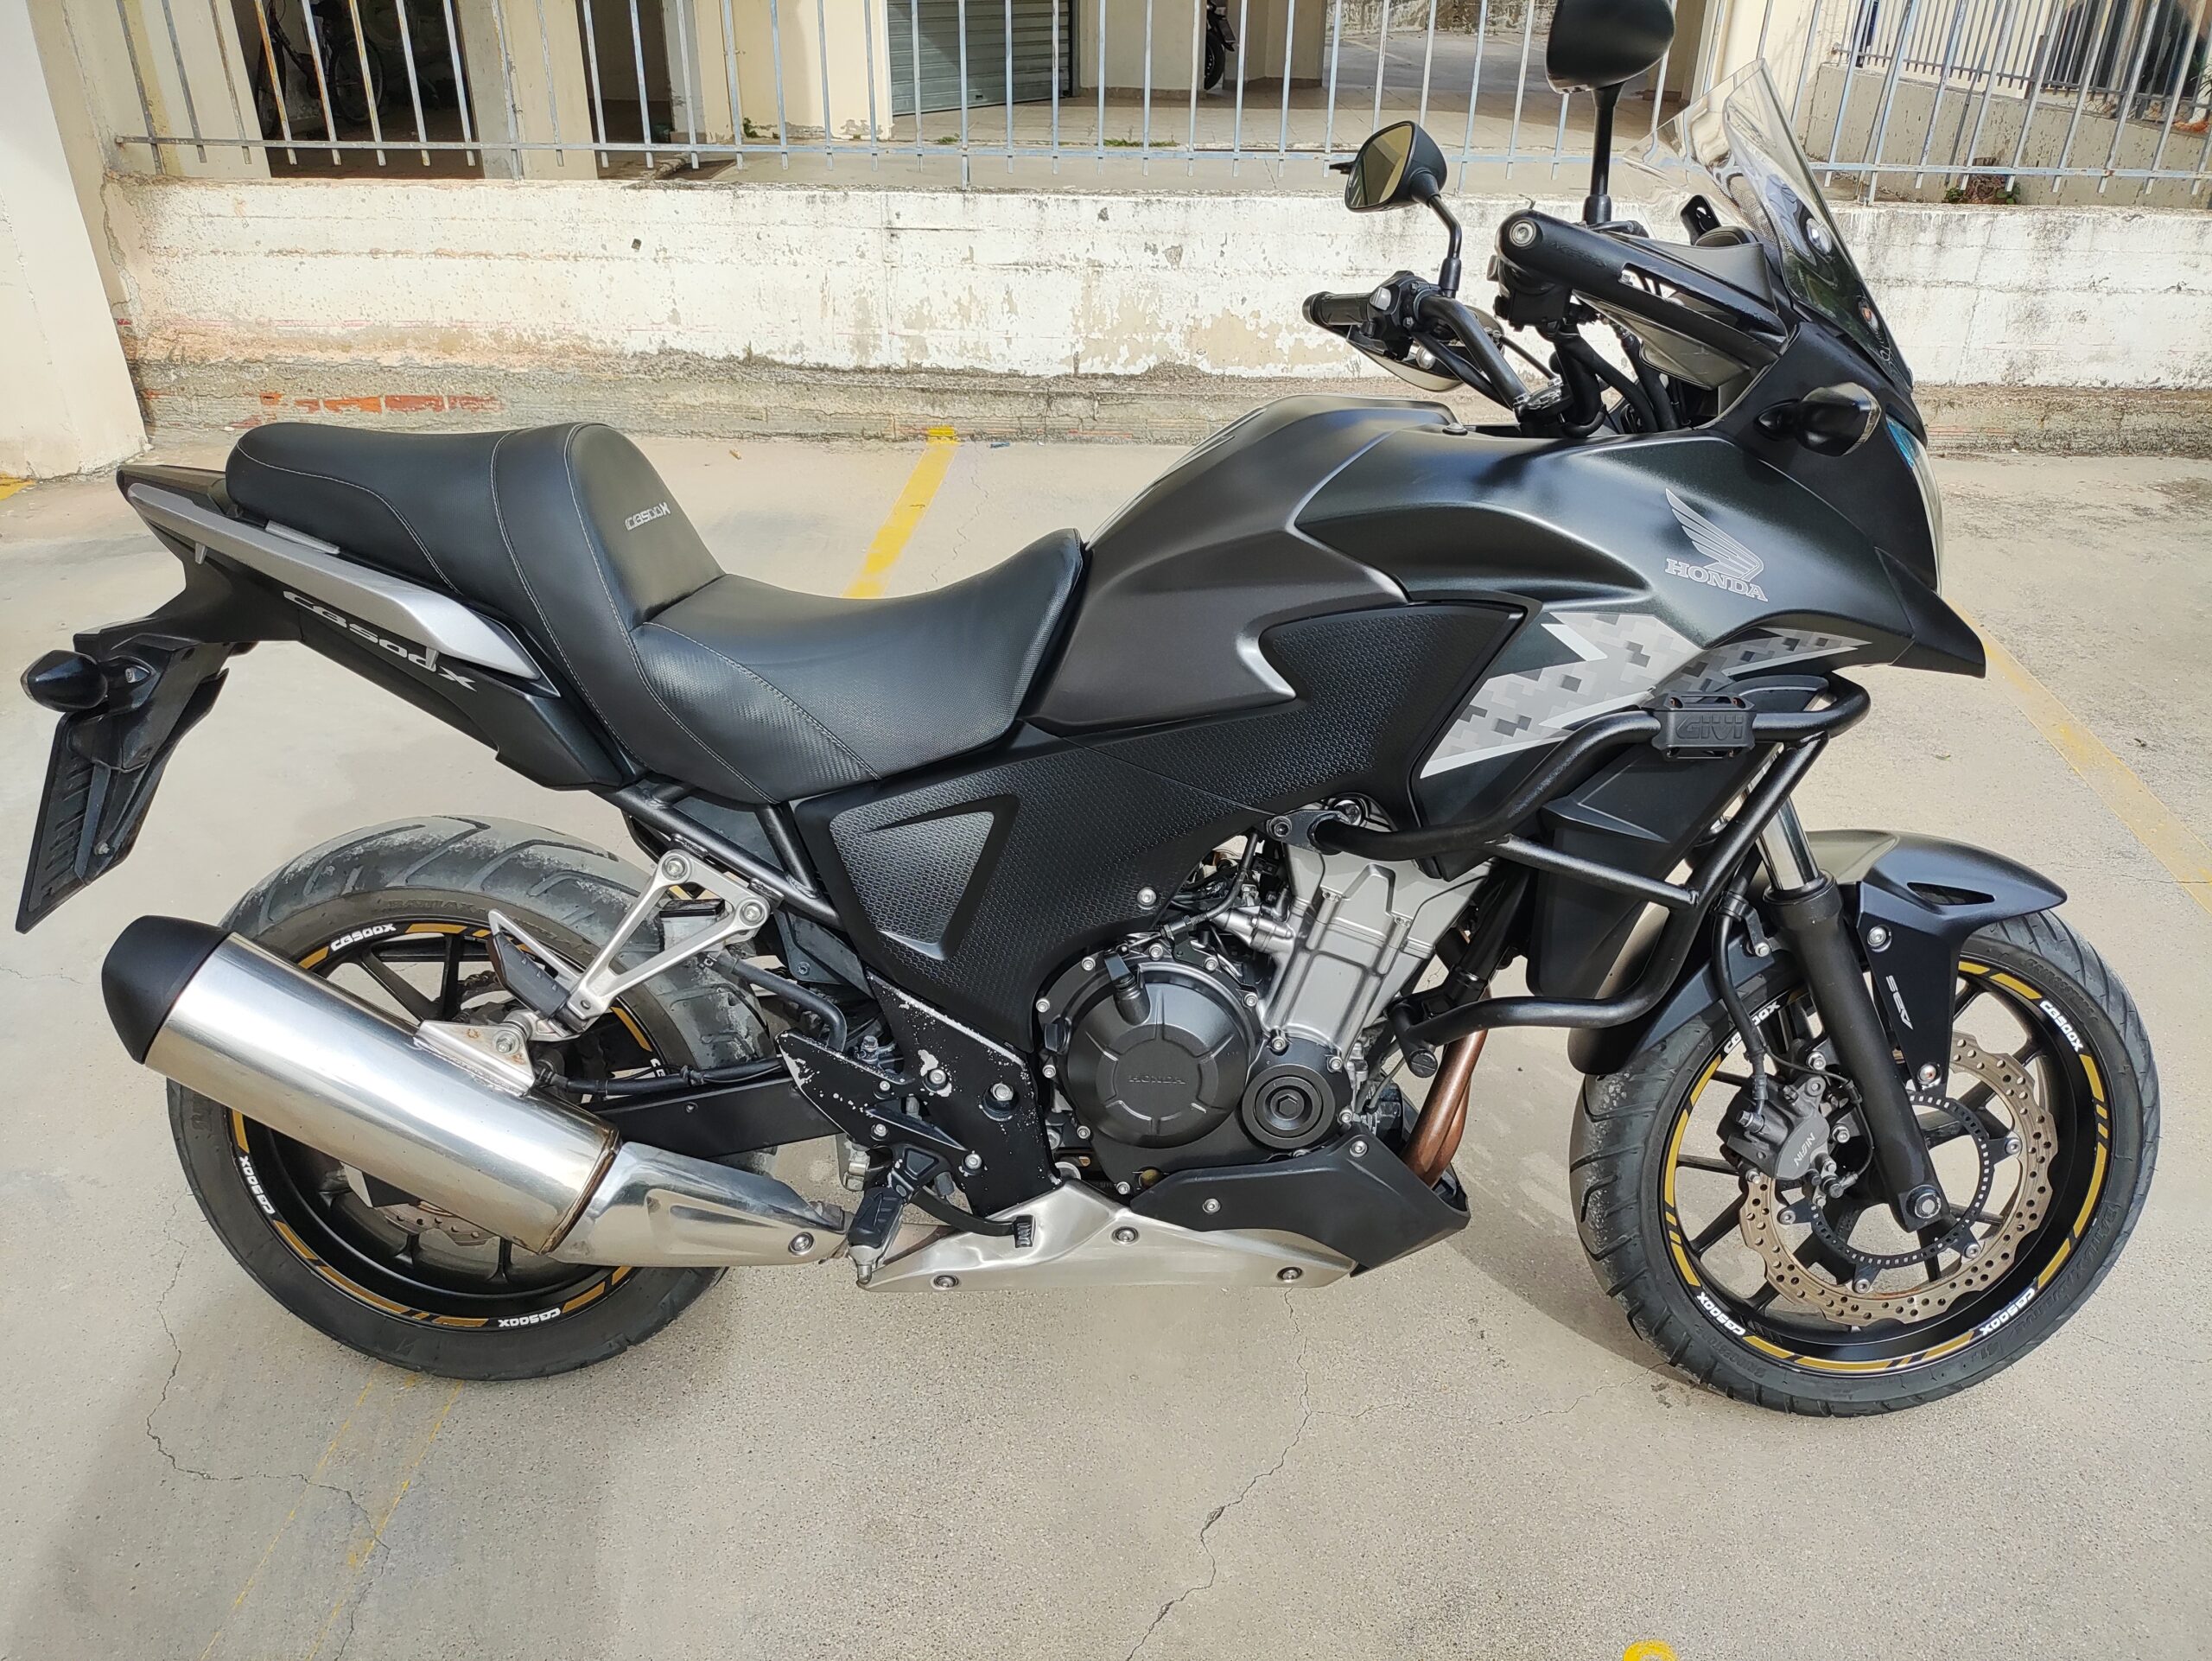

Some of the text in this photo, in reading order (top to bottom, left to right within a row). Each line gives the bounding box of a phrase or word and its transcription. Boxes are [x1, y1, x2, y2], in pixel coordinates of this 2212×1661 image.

[1665, 557, 1769, 602] HONDA
[283, 590, 477, 692] CB500X
[1676, 714, 1744, 741] GIVI
[330, 923, 397, 951] CB500X
[1885, 975, 1914, 1031] ABS
[2039, 1000, 2084, 1052] CB500X
[238, 1155, 276, 1214] CB500X
[498, 1308, 561, 1327] CB500X
[1696, 1291, 1746, 1336] CB500X
[1979, 1288, 2036, 1337] CB500X
